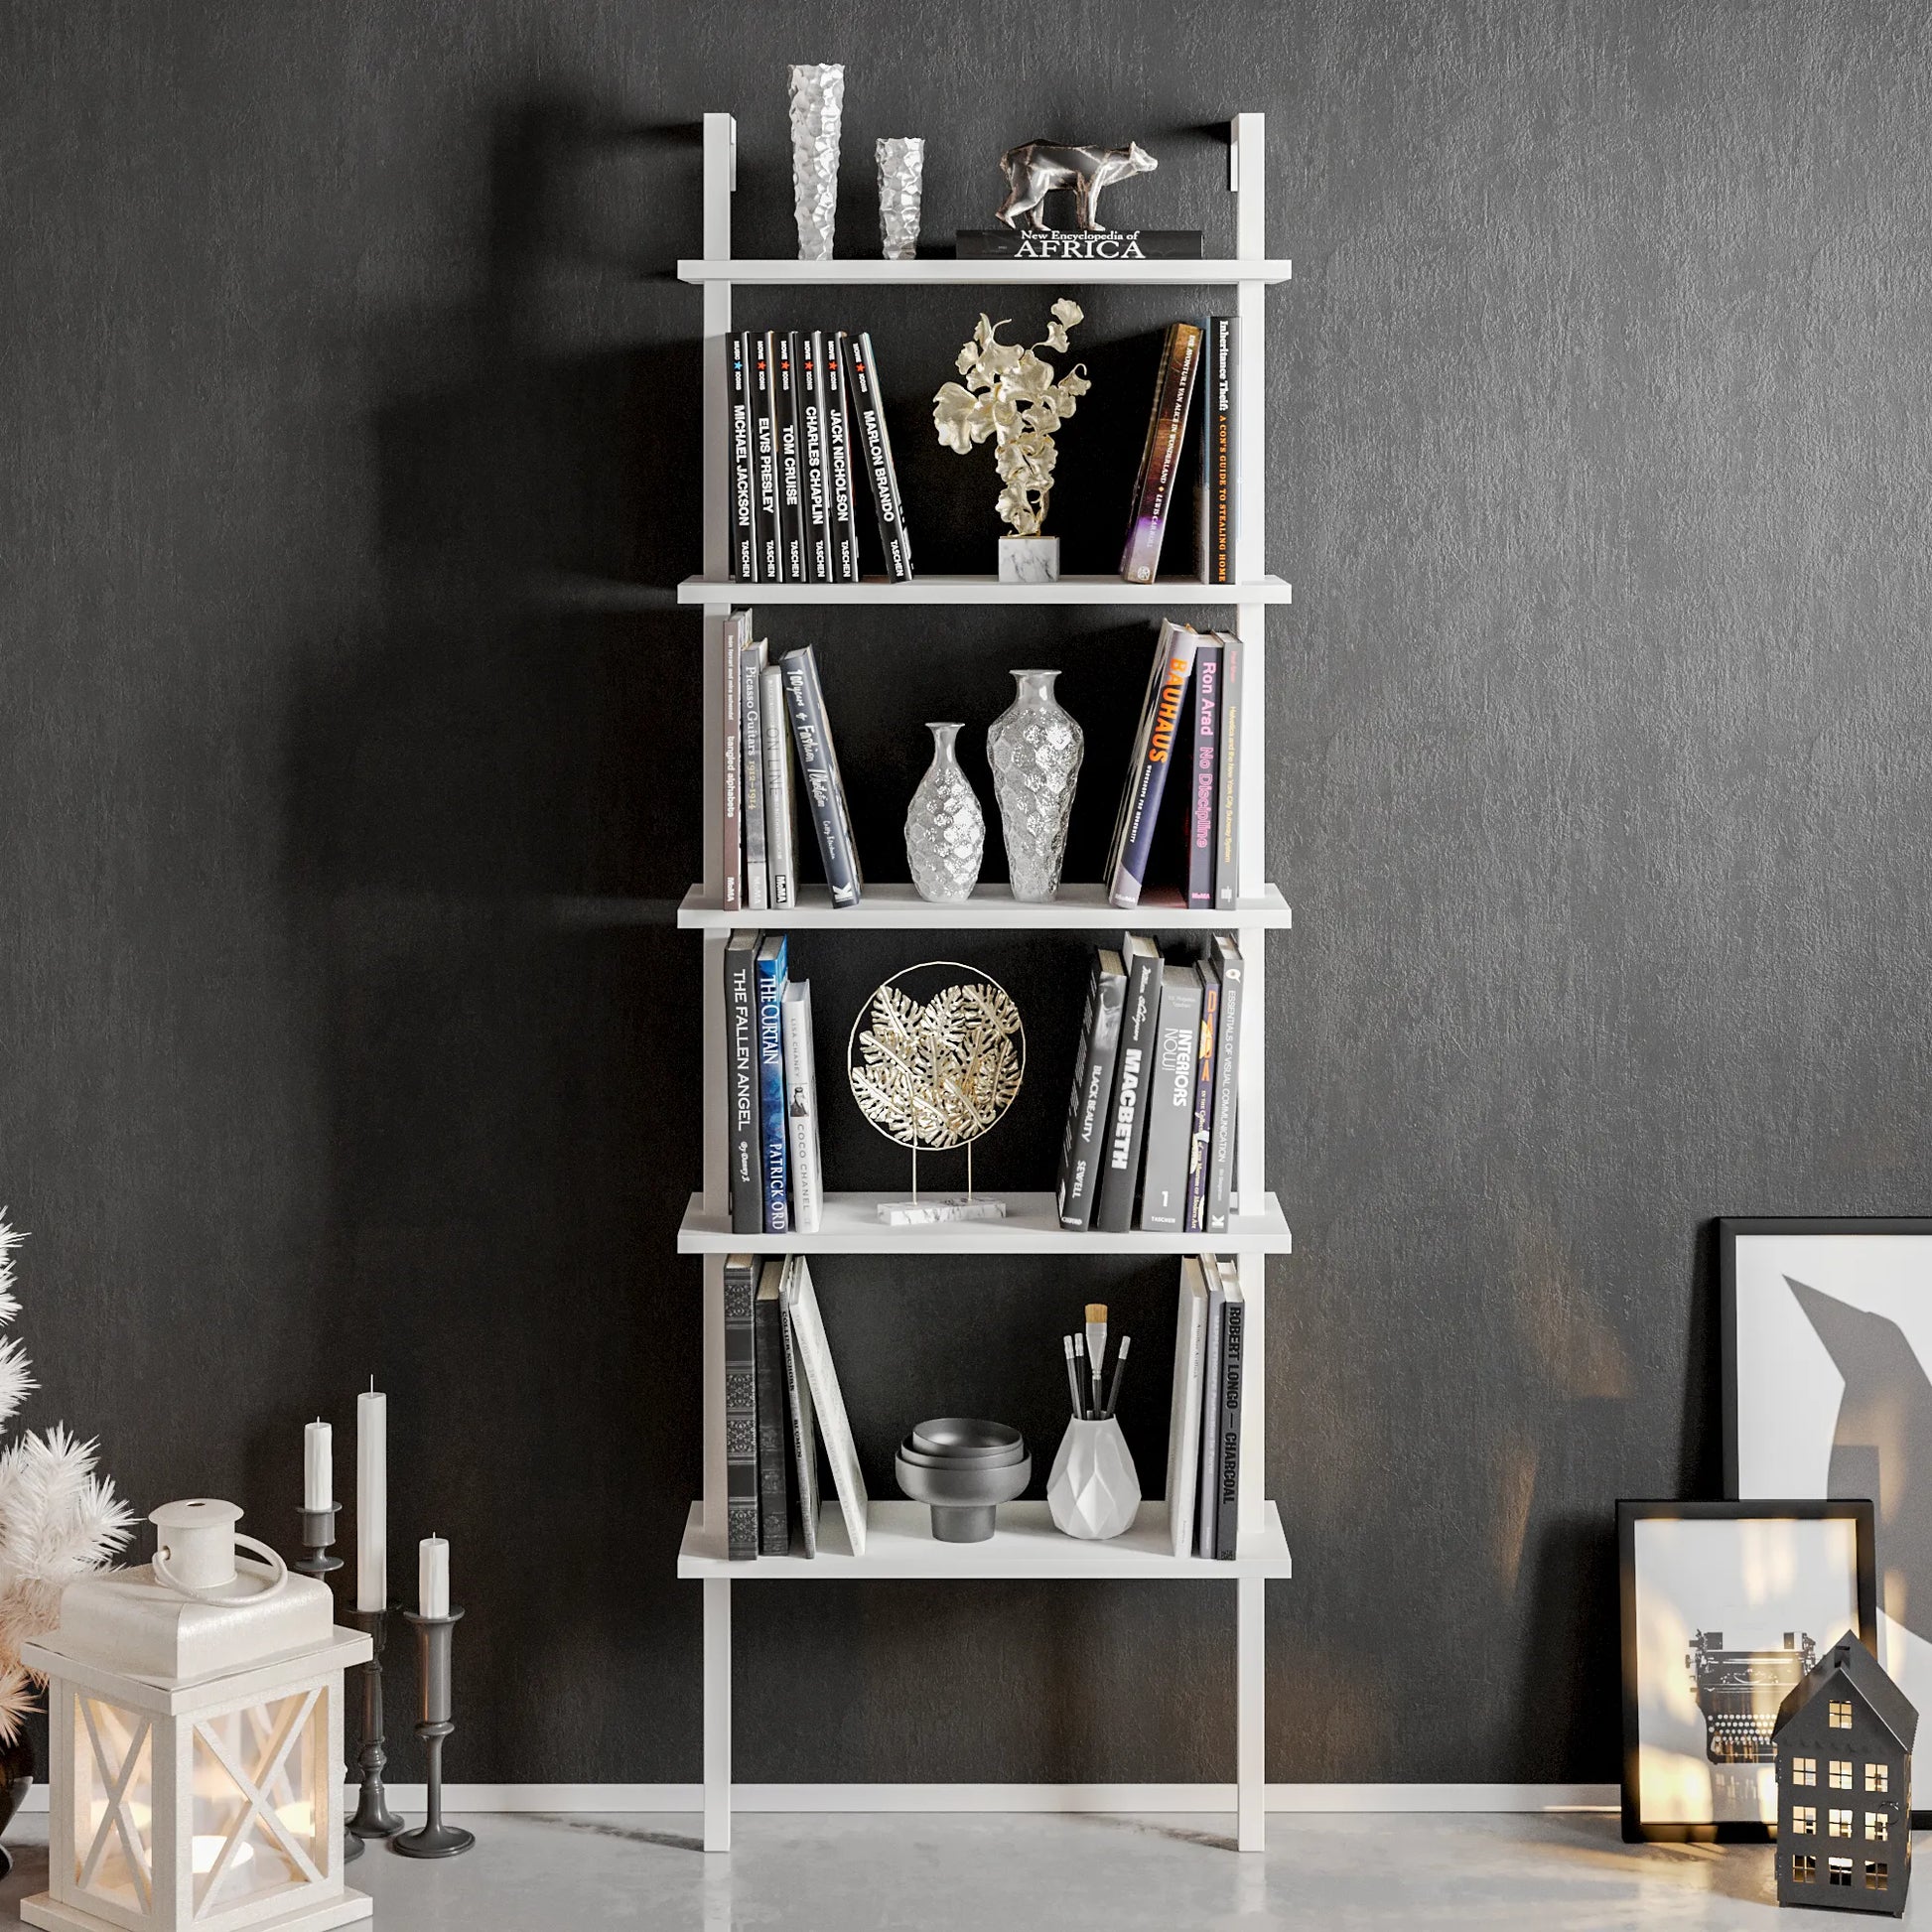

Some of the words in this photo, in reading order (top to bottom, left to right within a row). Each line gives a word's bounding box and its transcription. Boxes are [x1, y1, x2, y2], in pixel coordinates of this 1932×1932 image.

[1014, 240, 1146, 259] AFRICA
[1021, 229, 1049, 240] New
[1051, 230, 1123, 242] Encyclopedia
[1126, 230, 1141, 240] of
[1219, 320, 1229, 379] Inheritance
[1173, 403, 1182, 423] ALICE
[1176, 387, 1186, 402] VAN
[734, 404, 747, 462] MICHAEL
[759, 418, 769, 454] ELVIS
[782, 425, 794, 454] TOM
[805, 406, 819, 467] CHARLES
[830, 409, 843, 444] JACK
[1171, 424, 1177, 433] IN
[864, 410, 883, 467] MARLON
[876, 468, 894, 522] BRANDO
[1161, 434, 1176, 483] WONDERLAND
[737, 463, 750, 526] JACKSON
[760, 457, 774, 513] PRESLEY
[783, 458, 797, 505] CRUISE
[809, 470, 823, 525] CHAPLIN
[833, 446, 848, 522] NICHOLSON
[1219, 488, 1226, 501] TO
[1153, 494, 1164, 515] LEWIS
[741, 541, 750, 577] TASCHEN
[765, 541, 775, 577] TASCHEN
[790, 541, 799, 577] TASCHEN
[815, 541, 825, 578] TASCHEN
[841, 541, 850, 578] TASCHEN
[891, 540, 903, 577] TASCHEN
[746, 666, 757, 708] Picasso
[1201, 662, 1217, 694] Ron
[1149, 658, 1188, 763] BAUHAUS
[1200, 698, 1216, 736] Arad
[747, 711, 758, 757] Guitars
[766, 728, 779, 752] ON
[797, 725, 819, 762] Fashion
[726, 736, 735, 770] tangled
[1199, 747, 1214, 769] No
[726, 772, 735, 818] alphabets
[768, 759, 782, 796] LINE
[1195, 773, 1213, 849] Discipline
[776, 876, 785, 903] MoMA
[734, 969, 748, 1003] THE
[759, 975, 777, 1003] THE
[760, 1004, 780, 1064] CURTAIN
[1225, 991, 1236, 1041] ESSENTIALS
[736, 1006, 750, 1070] FALLEN
[1224, 1043, 1233, 1056] OF
[1088, 1065, 1102, 1100] BLACK
[1173, 1029, 1192, 1107] INTERIORS
[1222, 1057, 1232, 1086] VISUAL
[738, 1073, 751, 1132] ANGEL
[1111, 1048, 1143, 1170] MACBETH
[1082, 1100, 1097, 1143] BEAUTY
[1218, 1089, 1230, 1163] COMMUNICATION
[797, 1123, 806, 1159] COCO
[769, 1143, 784, 1197] PATRICK
[800, 1164, 810, 1210] CHANEL
[1072, 1160, 1086, 1198] SEWELL
[770, 1201, 785, 1230] ORD
[1162, 1191, 1169, 1207] 1
[782, 1311, 791, 1350] COLLIER
[1228, 1307, 1241, 1361] ROBERT
[1226, 1364, 1239, 1410] LONGO
[1223, 1432, 1238, 1505] CHARCOAL
